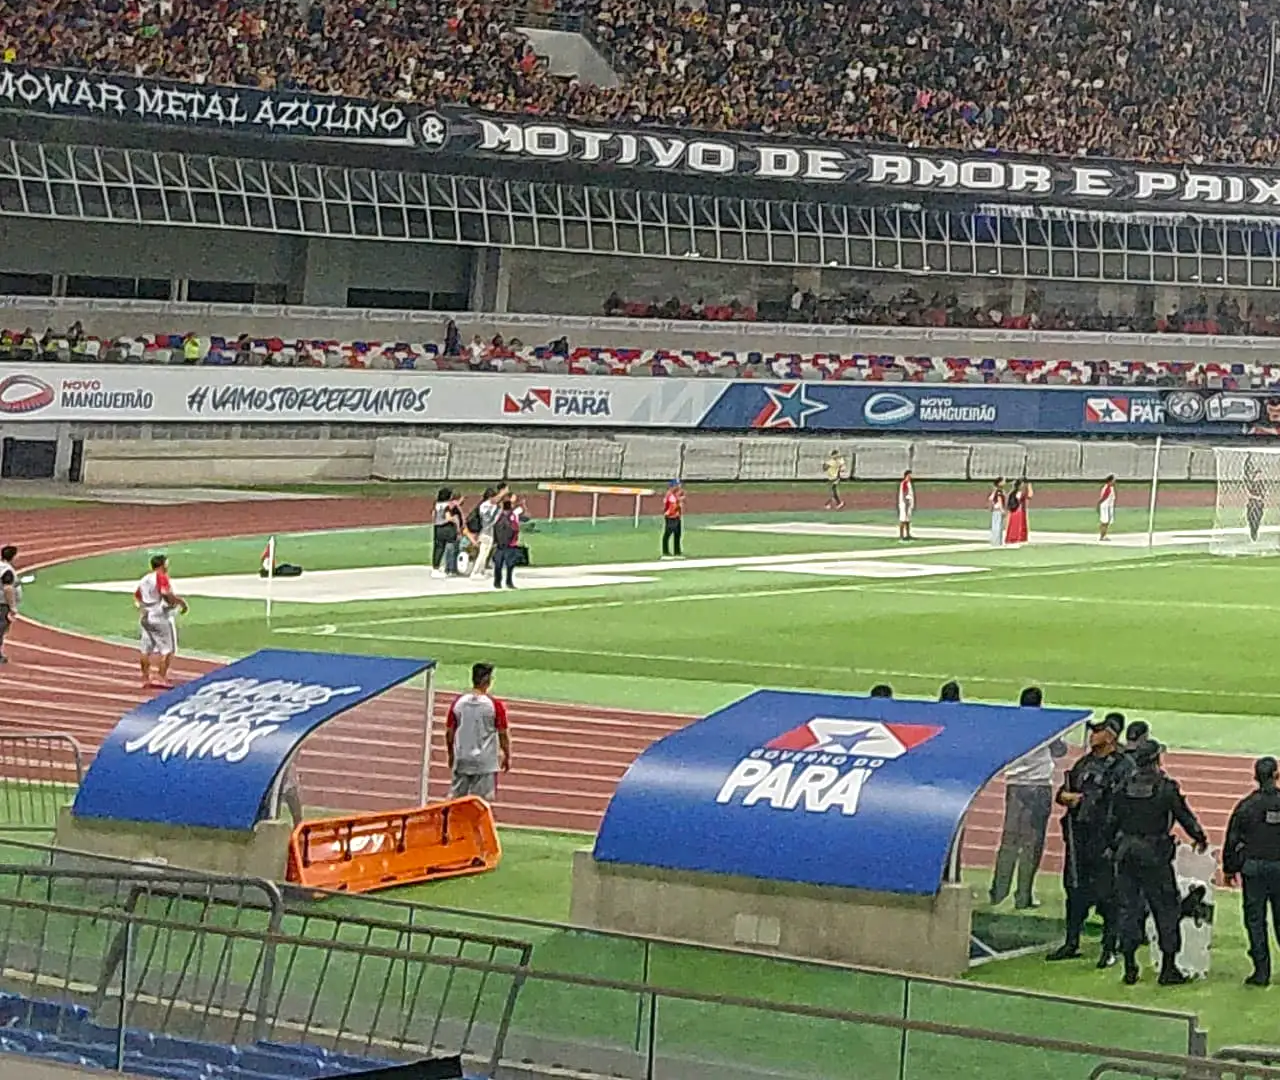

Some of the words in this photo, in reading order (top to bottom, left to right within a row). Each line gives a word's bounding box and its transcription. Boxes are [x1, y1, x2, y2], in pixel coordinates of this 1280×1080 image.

[135, 85, 248, 127] METAL
[252, 95, 405, 137] AZULINO
[476, 120, 736, 172] MOTIVO
[754, 146, 848, 179] DE
[866, 153, 1052, 195] AMOR
[1070, 166, 1115, 197] E
[63, 380, 100, 391] NOVO
[61, 388, 154, 409] MANGUEIRÃO
[186, 385, 430, 413] #VAMOSTORCERJUNTOS
[553, 395, 611, 416] PARÁ
[919, 398, 952, 406] NOVO
[919, 404, 996, 422] MANGUEIRÃO
[749, 748, 843, 767] GOVERNO
[852, 758, 884, 769] DO
[715, 759, 873, 816] PARÁ
